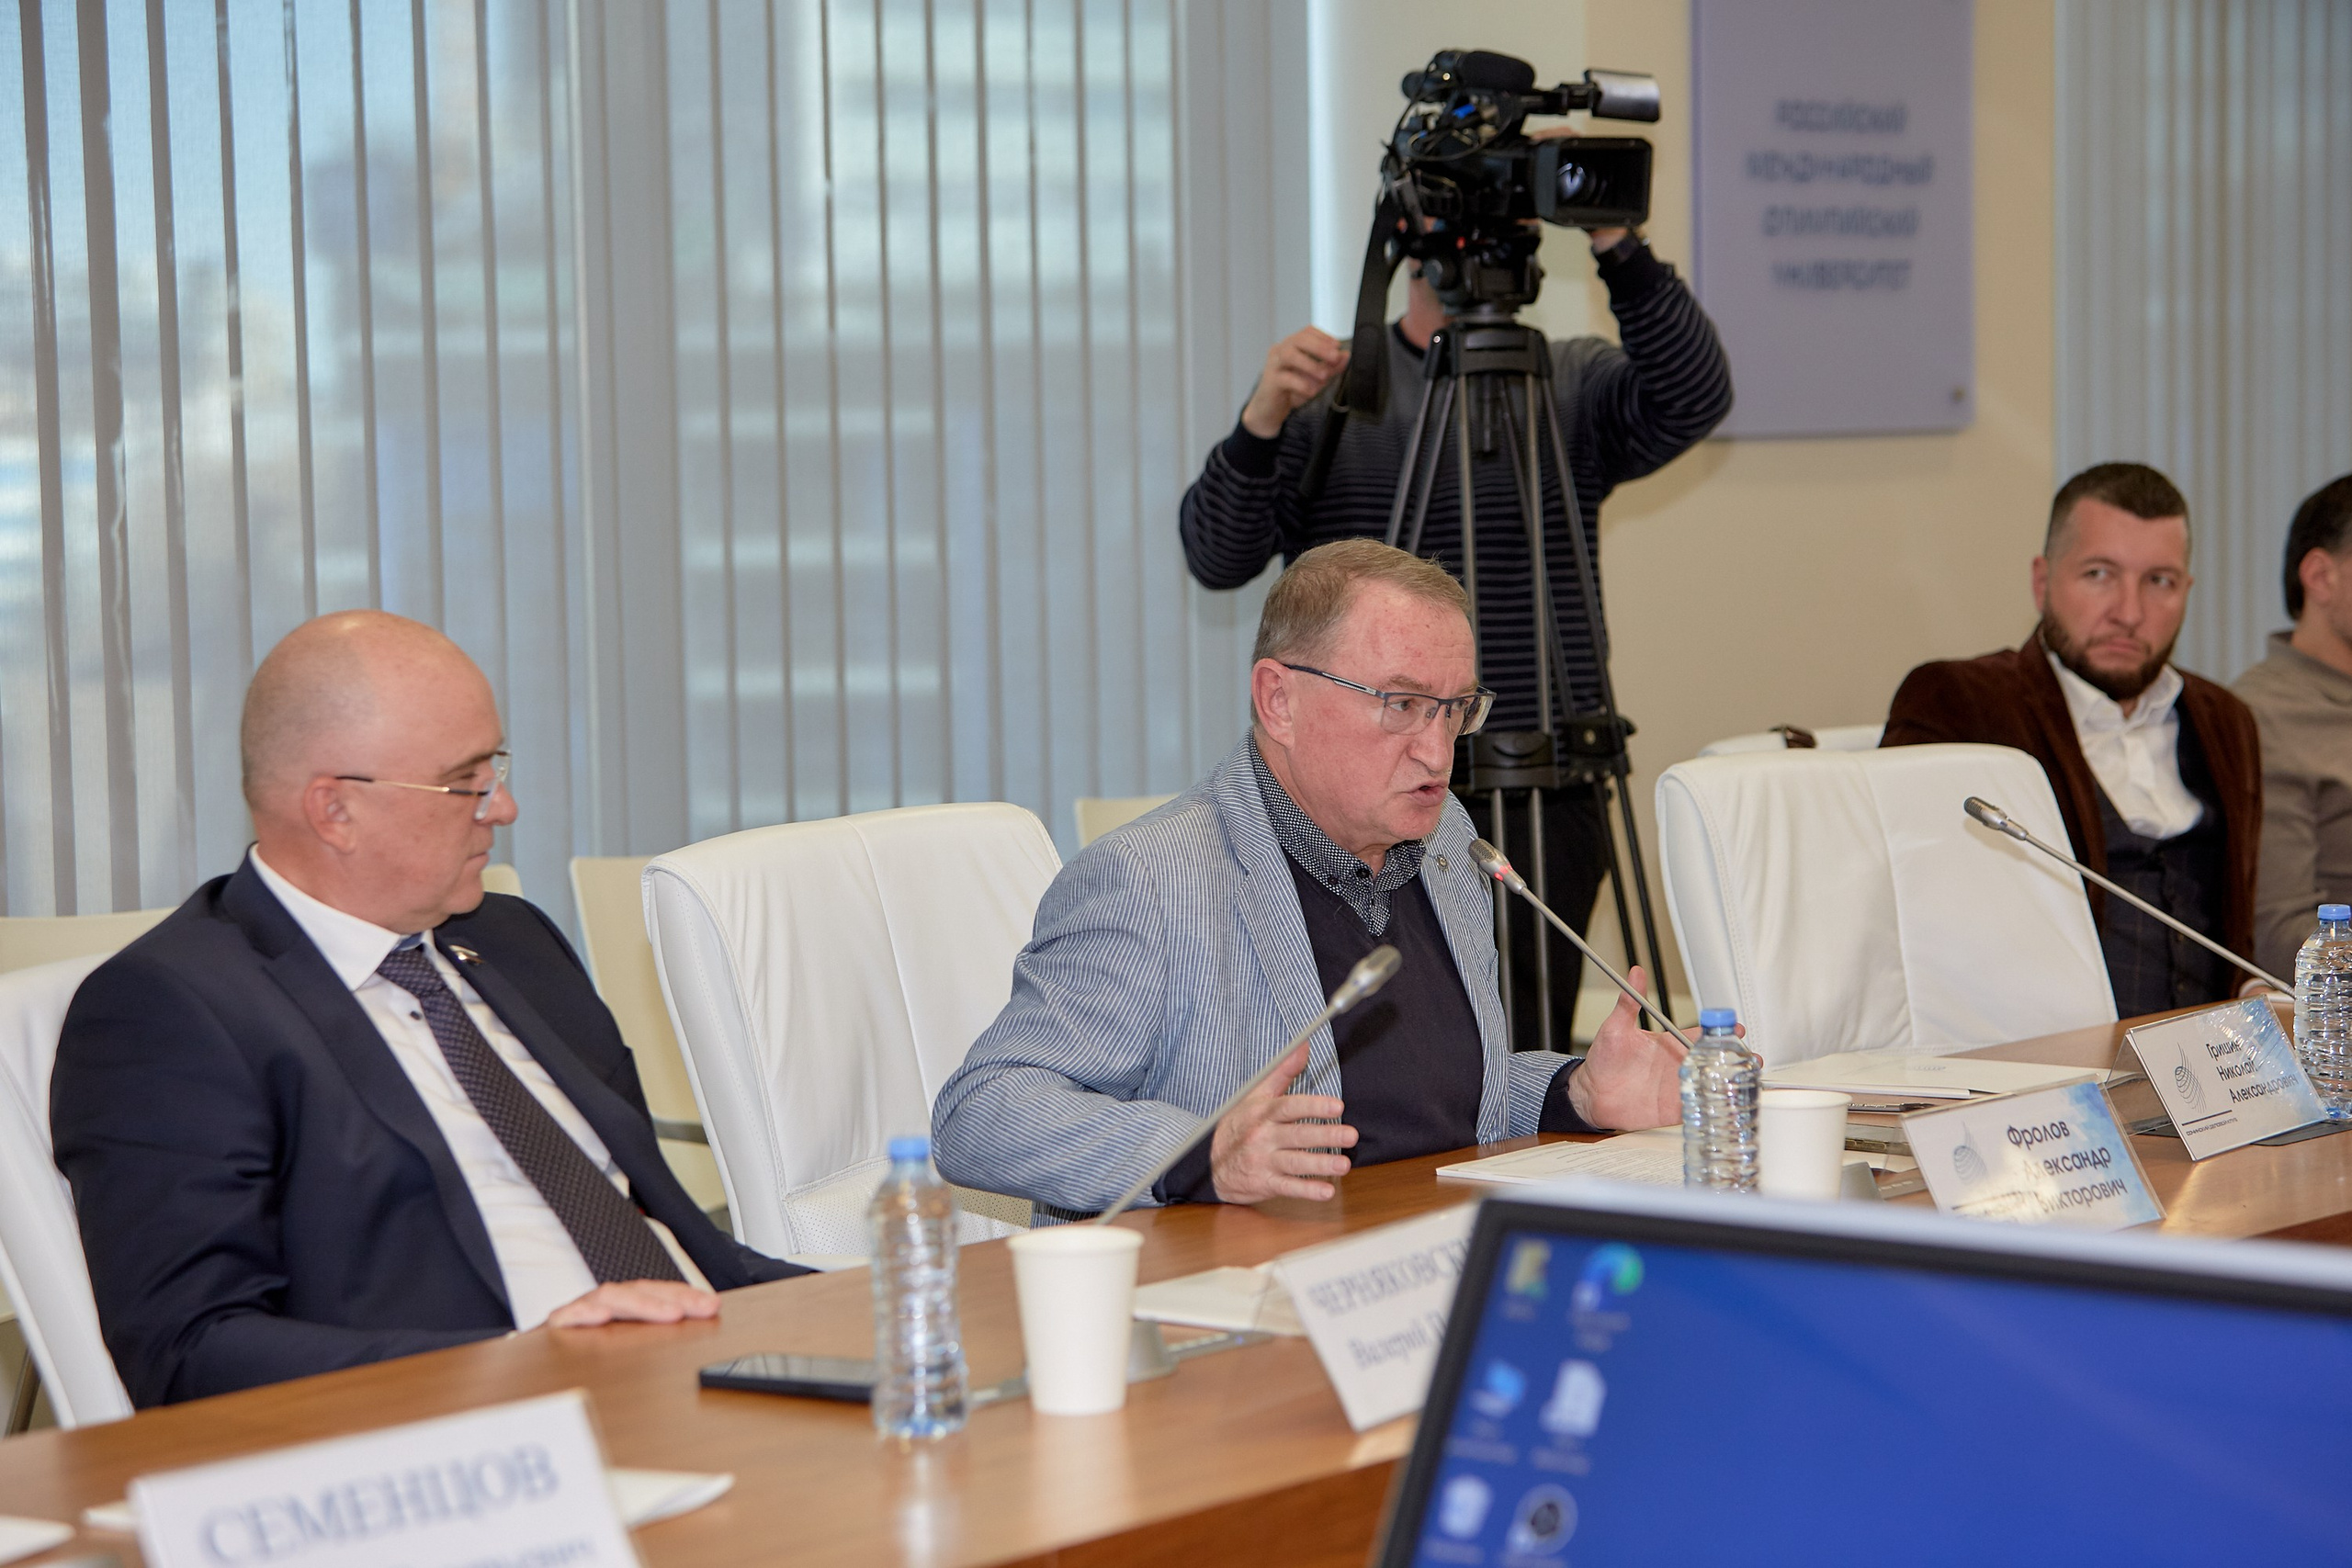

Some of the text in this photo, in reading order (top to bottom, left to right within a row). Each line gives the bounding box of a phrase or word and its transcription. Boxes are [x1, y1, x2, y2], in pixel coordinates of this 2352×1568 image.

[2216, 1059, 2258, 1081] Николай
[2229, 1073, 2300, 1103] Александрович
[2007, 1121, 2070, 1150] Фролов
[198, 1445, 559, 1562] СЕМЕНЦОВ
